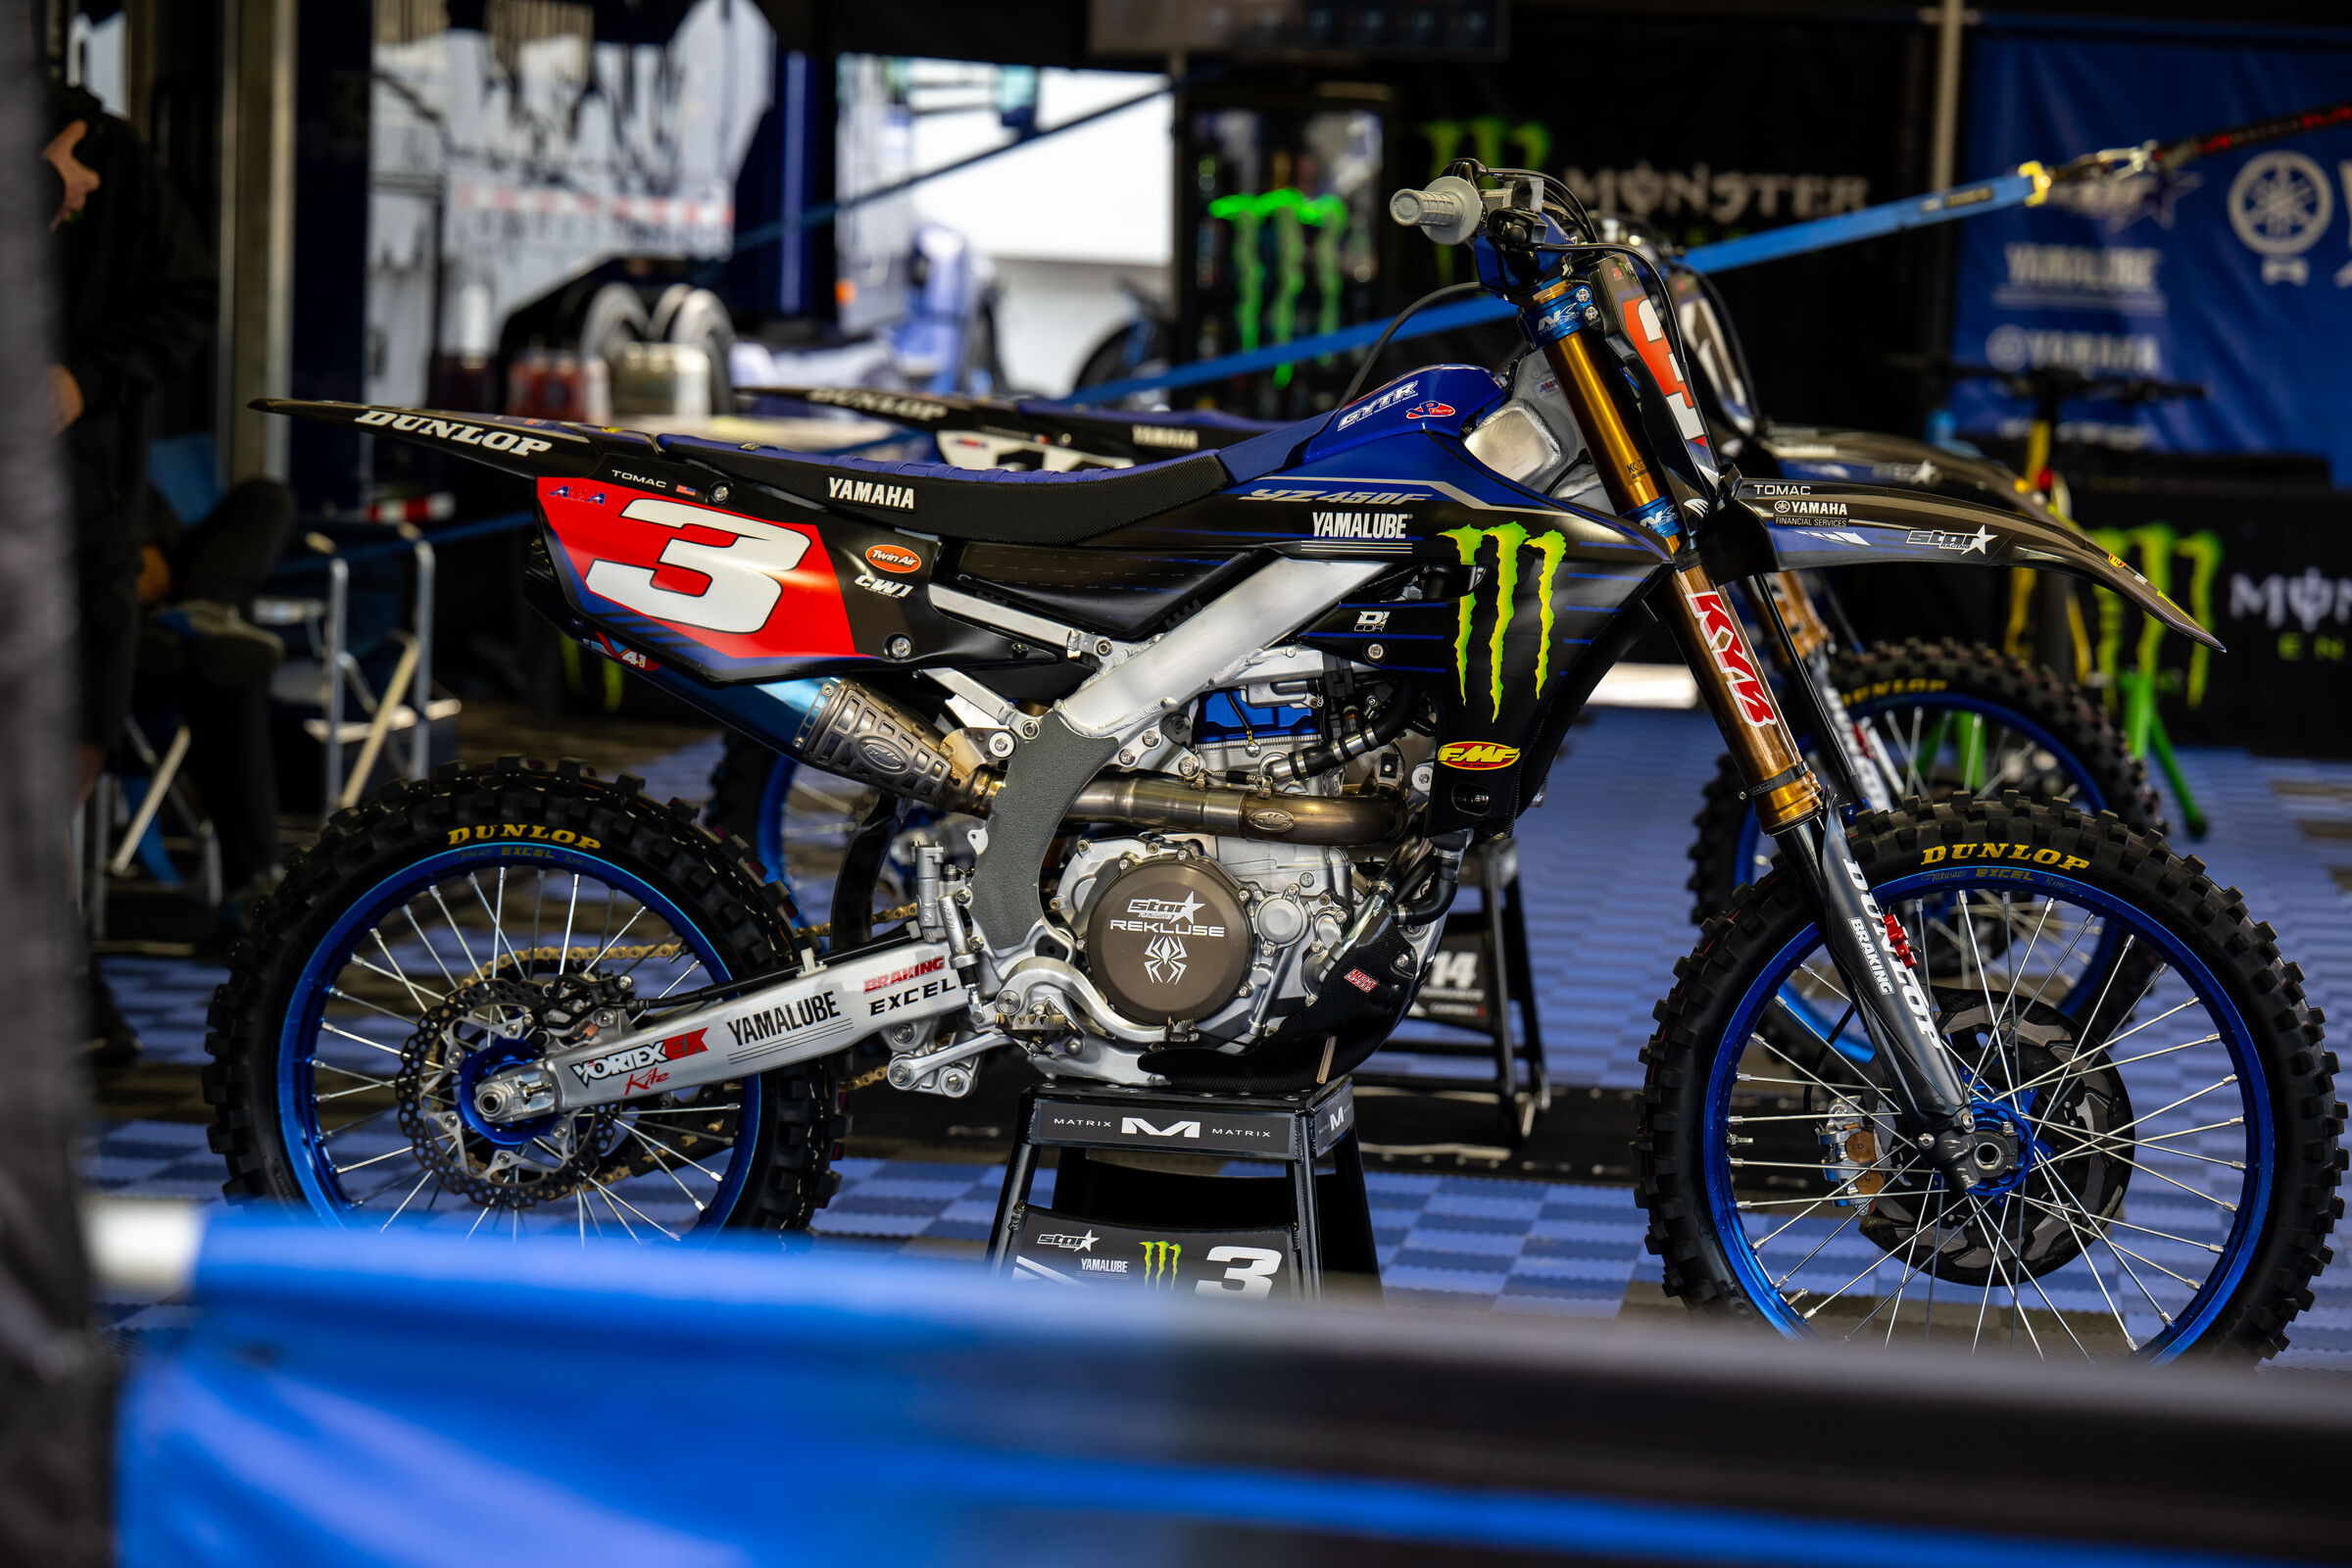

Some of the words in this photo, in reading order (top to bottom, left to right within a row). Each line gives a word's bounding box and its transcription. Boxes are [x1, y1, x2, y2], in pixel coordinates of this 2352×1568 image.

[1337, 382, 1419, 428] GYTR
[354, 410, 553, 457] DUNLOP
[1133, 425, 1199, 449] YAMAHA
[612, 469, 667, 488] TOMAC
[1754, 484, 1811, 496] TOMAC
[827, 476, 914, 510] YAMAHA
[1791, 501, 1848, 515] YAMAHA
[1312, 512, 1408, 539] YAMALUBE
[1775, 516, 1812, 527] FINANCIAL
[1814, 518, 1847, 528] SERVICES
[585, 498, 811, 635] 3
[872, 549, 900, 563] Twin
[898, 555, 918, 565] Air
[1686, 591, 1777, 727] KYB
[1438, 745, 1520, 762] FMF
[447, 823, 602, 850] DUNLOP
[501, 847, 555, 859] EXCEL
[1920, 843, 2090, 870] DUNLOP
[1975, 868, 2034, 881] EXCEL
[1110, 919, 1225, 938] REKLUSE
[1430, 951, 1478, 989] 14
[1850, 918, 1894, 995] BRAKING
[863, 956, 946, 994] BRAKING
[868, 978, 957, 1016] EXCEL
[726, 991, 841, 1046] YAMALUBE
[569, 1040, 671, 1089] VORTEX
[624, 1067, 670, 1096] Kite
[1054, 1117, 1112, 1127] MATRIX
[1211, 1127, 1271, 1138] MATRIX
[1081, 1257, 1128, 1274] YAMALUBE
[1195, 1246, 1282, 1300] 3
